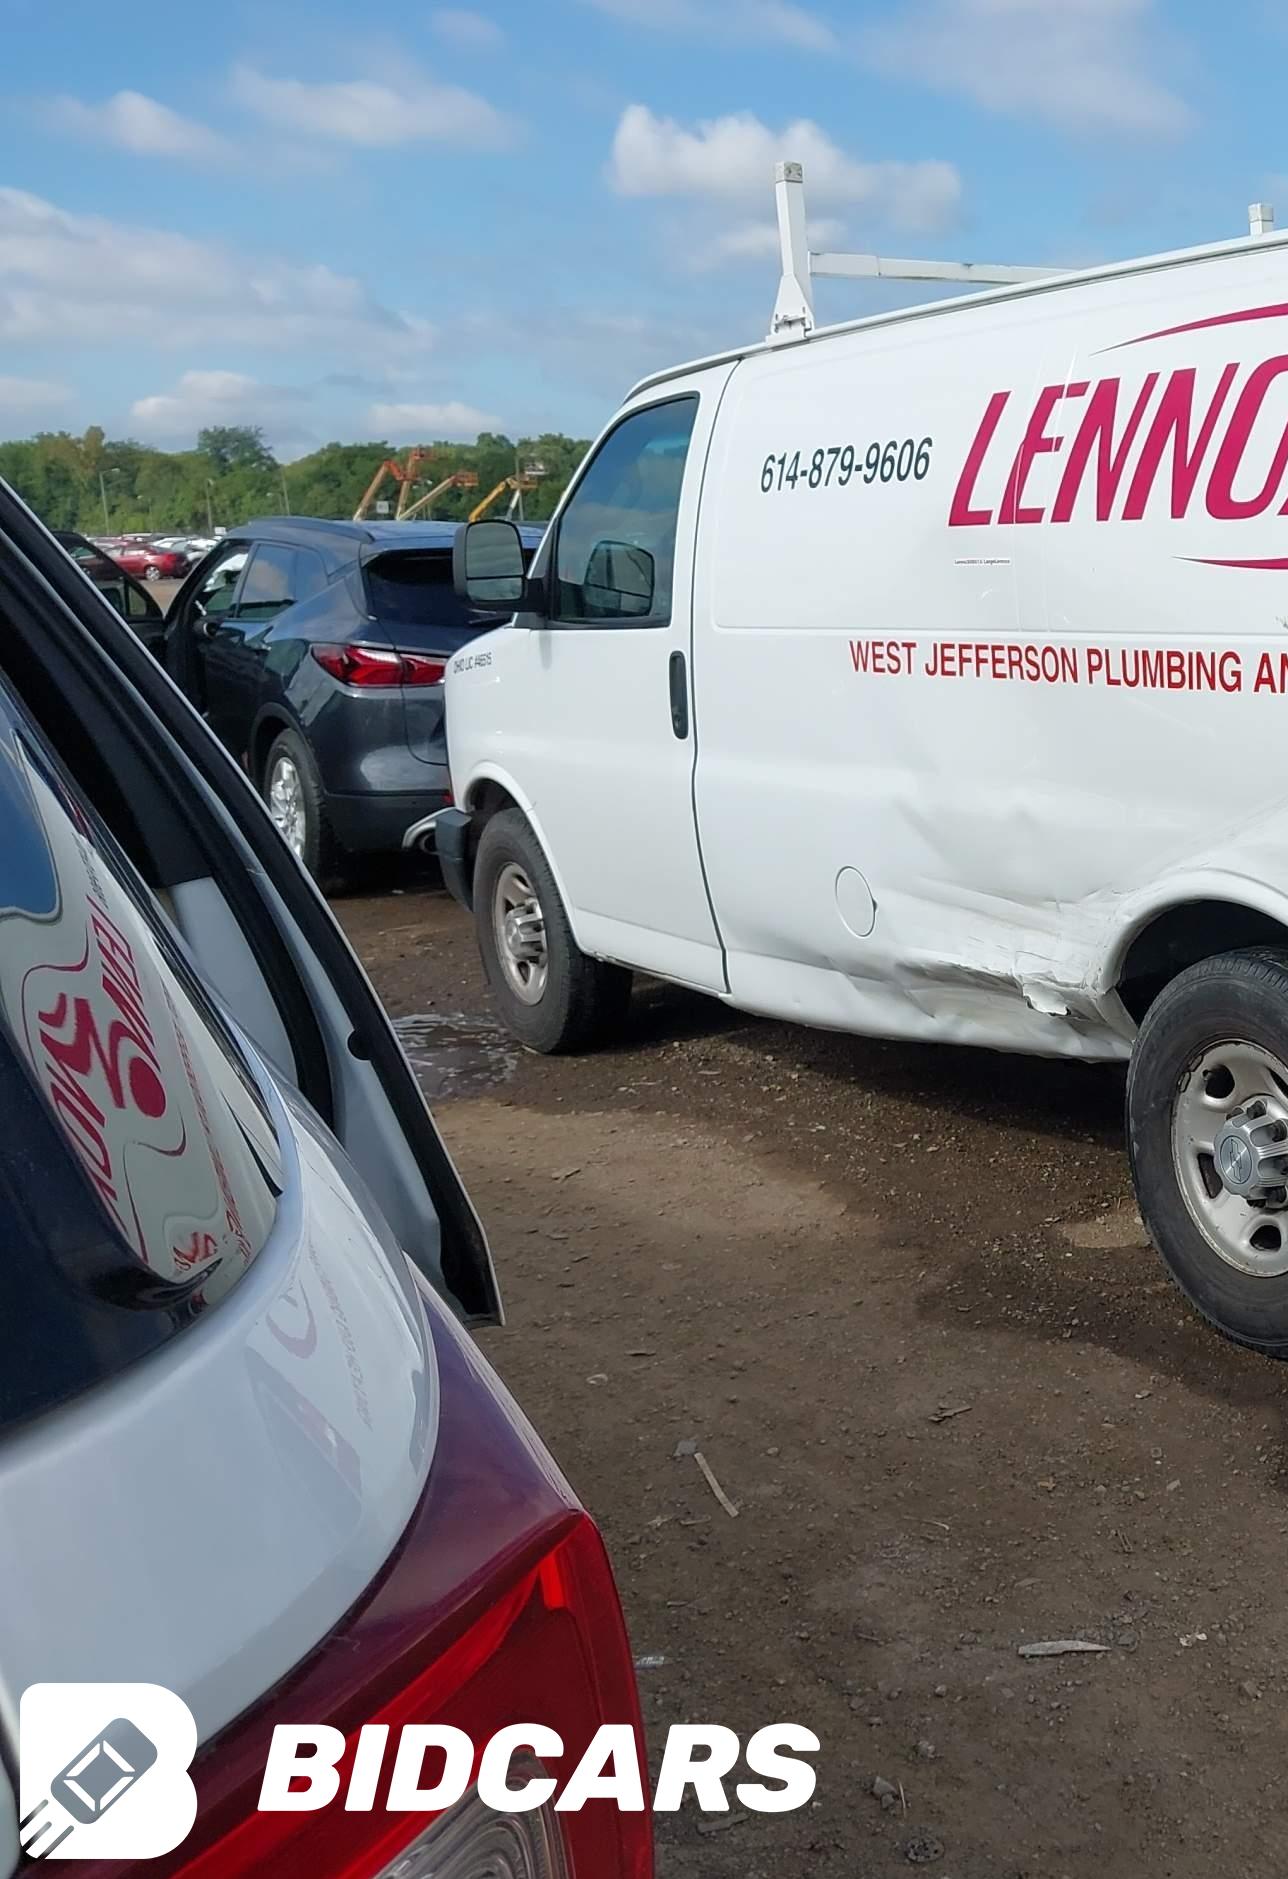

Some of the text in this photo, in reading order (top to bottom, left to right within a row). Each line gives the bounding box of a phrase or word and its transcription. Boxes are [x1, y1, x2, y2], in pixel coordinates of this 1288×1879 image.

[760, 437, 933, 493] 614-879-9606
[849, 640, 917, 675] WEST
[925, 642, 1078, 683] JEFFERSON
[1086, 648, 1242, 692] PLUMBING
